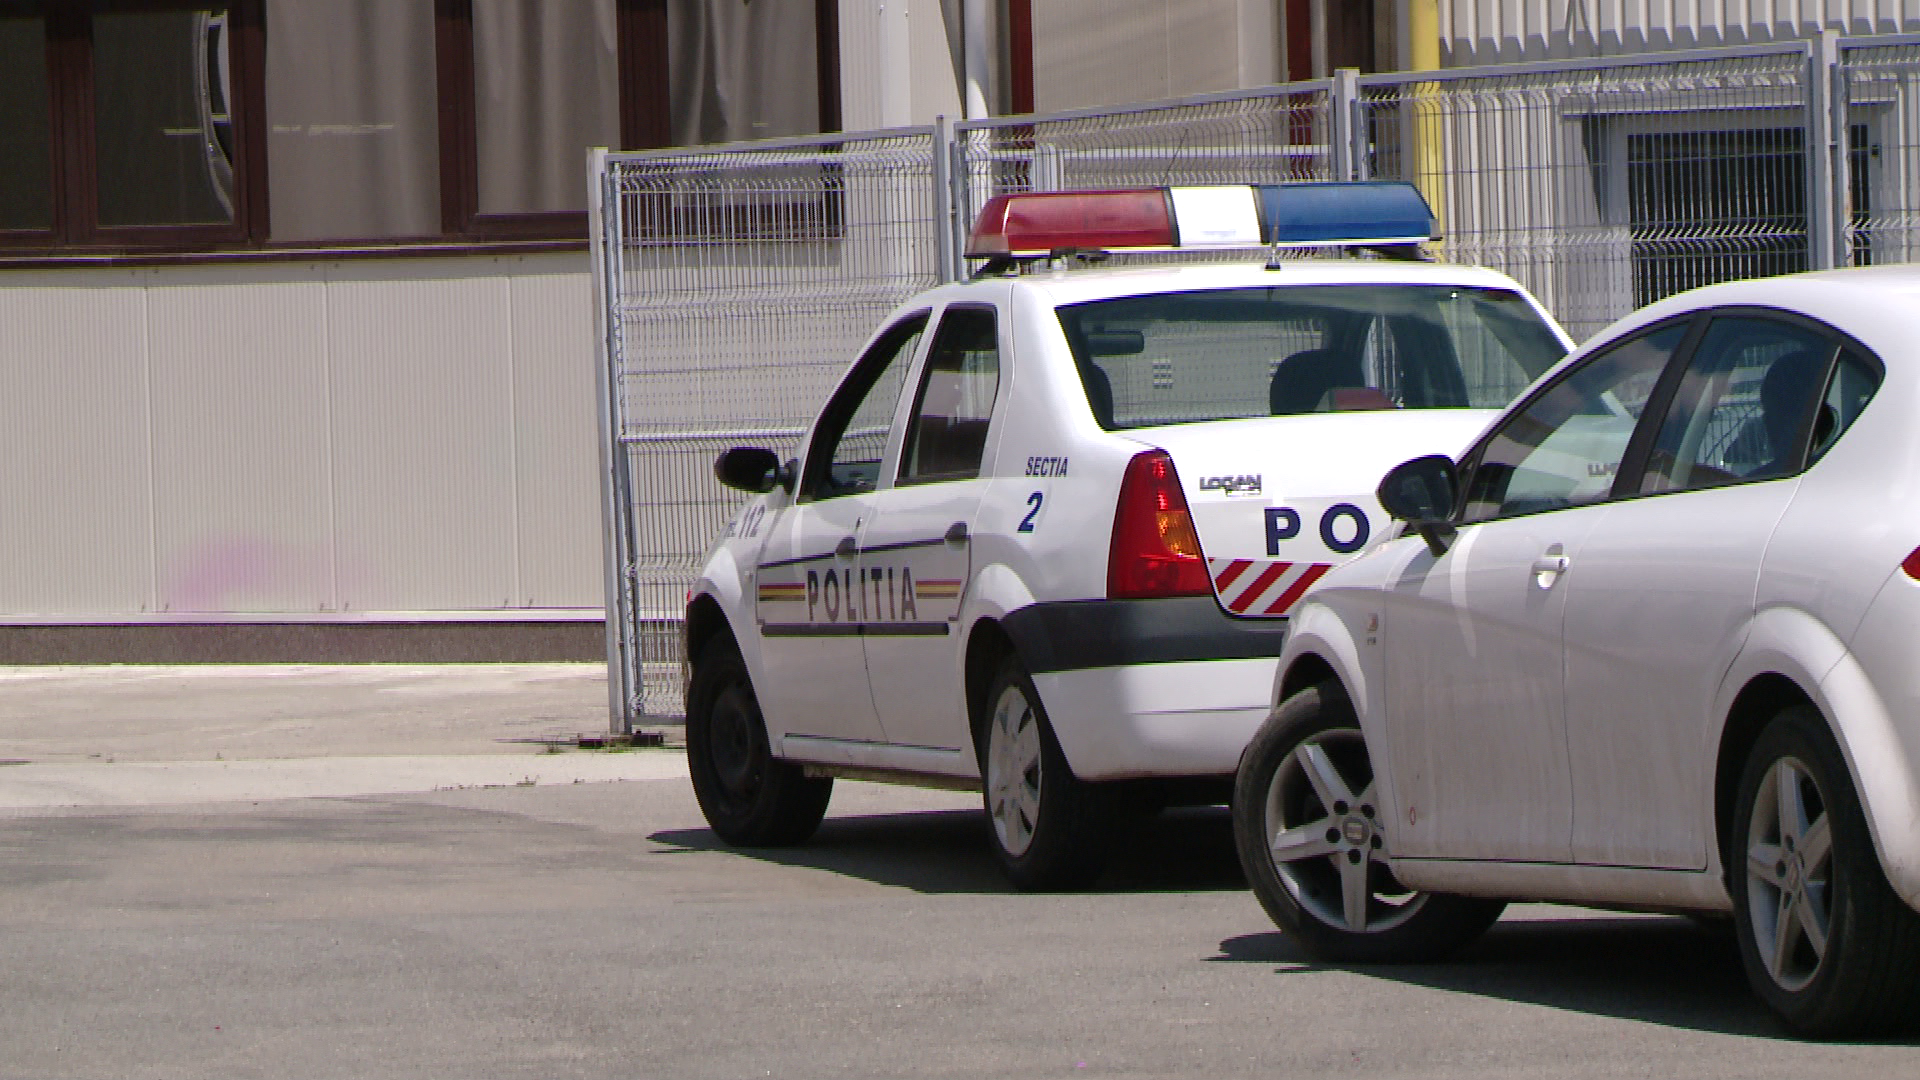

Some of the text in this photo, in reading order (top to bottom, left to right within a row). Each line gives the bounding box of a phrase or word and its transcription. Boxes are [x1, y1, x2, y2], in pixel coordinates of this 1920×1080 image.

[1025, 456, 1069, 477] SECTIA
[1199, 474, 1262, 490] LOGAN
[738, 504, 766, 539] 112
[1017, 491, 1044, 533] 2
[806, 566, 917, 623] POLITIA
